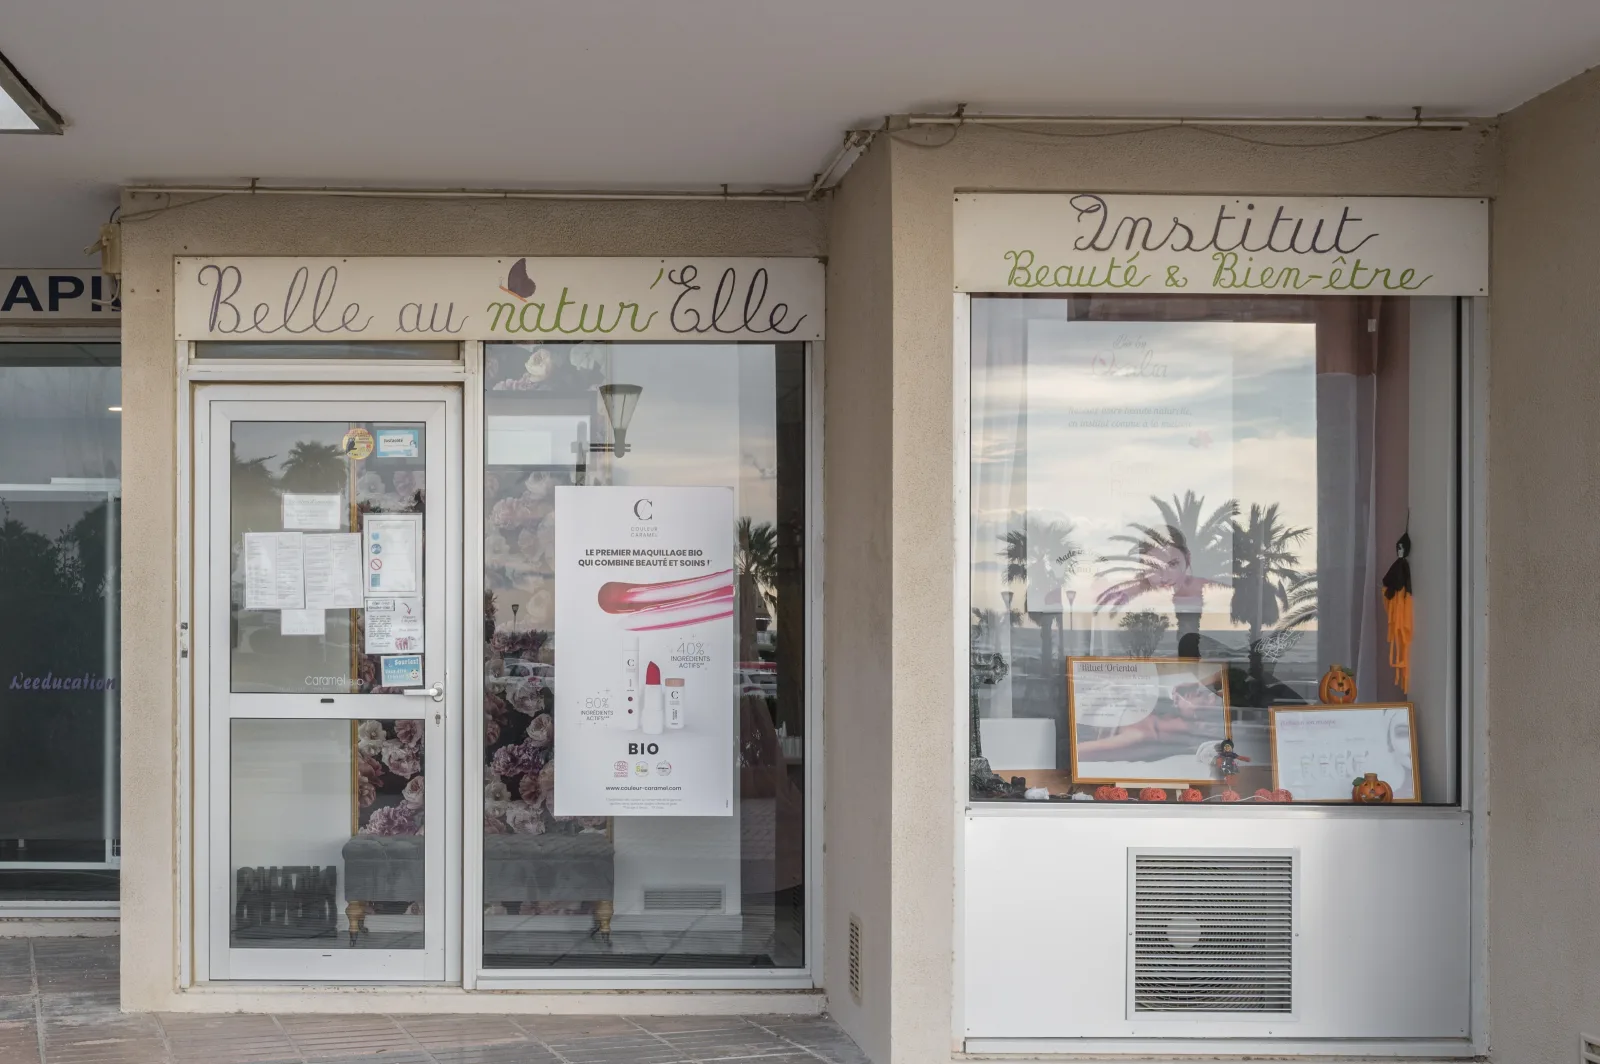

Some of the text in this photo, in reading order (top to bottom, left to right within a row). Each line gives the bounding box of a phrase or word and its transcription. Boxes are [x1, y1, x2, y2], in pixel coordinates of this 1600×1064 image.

[1070, 194, 1380, 255] Institut
[1004, 249, 1433, 291] Beauté & Bien-être
[0, 275, 121, 311] API
[197, 264, 375, 333] Belle
[395, 301, 470, 333] au
[632, 549, 687, 557] MAQUILLAGE
[578, 559, 593, 567] QUI
[594, 559, 635, 567] COMBINE
[635, 557, 667, 566] BEAUTÉ
[676, 642, 705, 655] 40%
[585, 697, 609, 709] 80%
[628, 742, 659, 755] BIO
